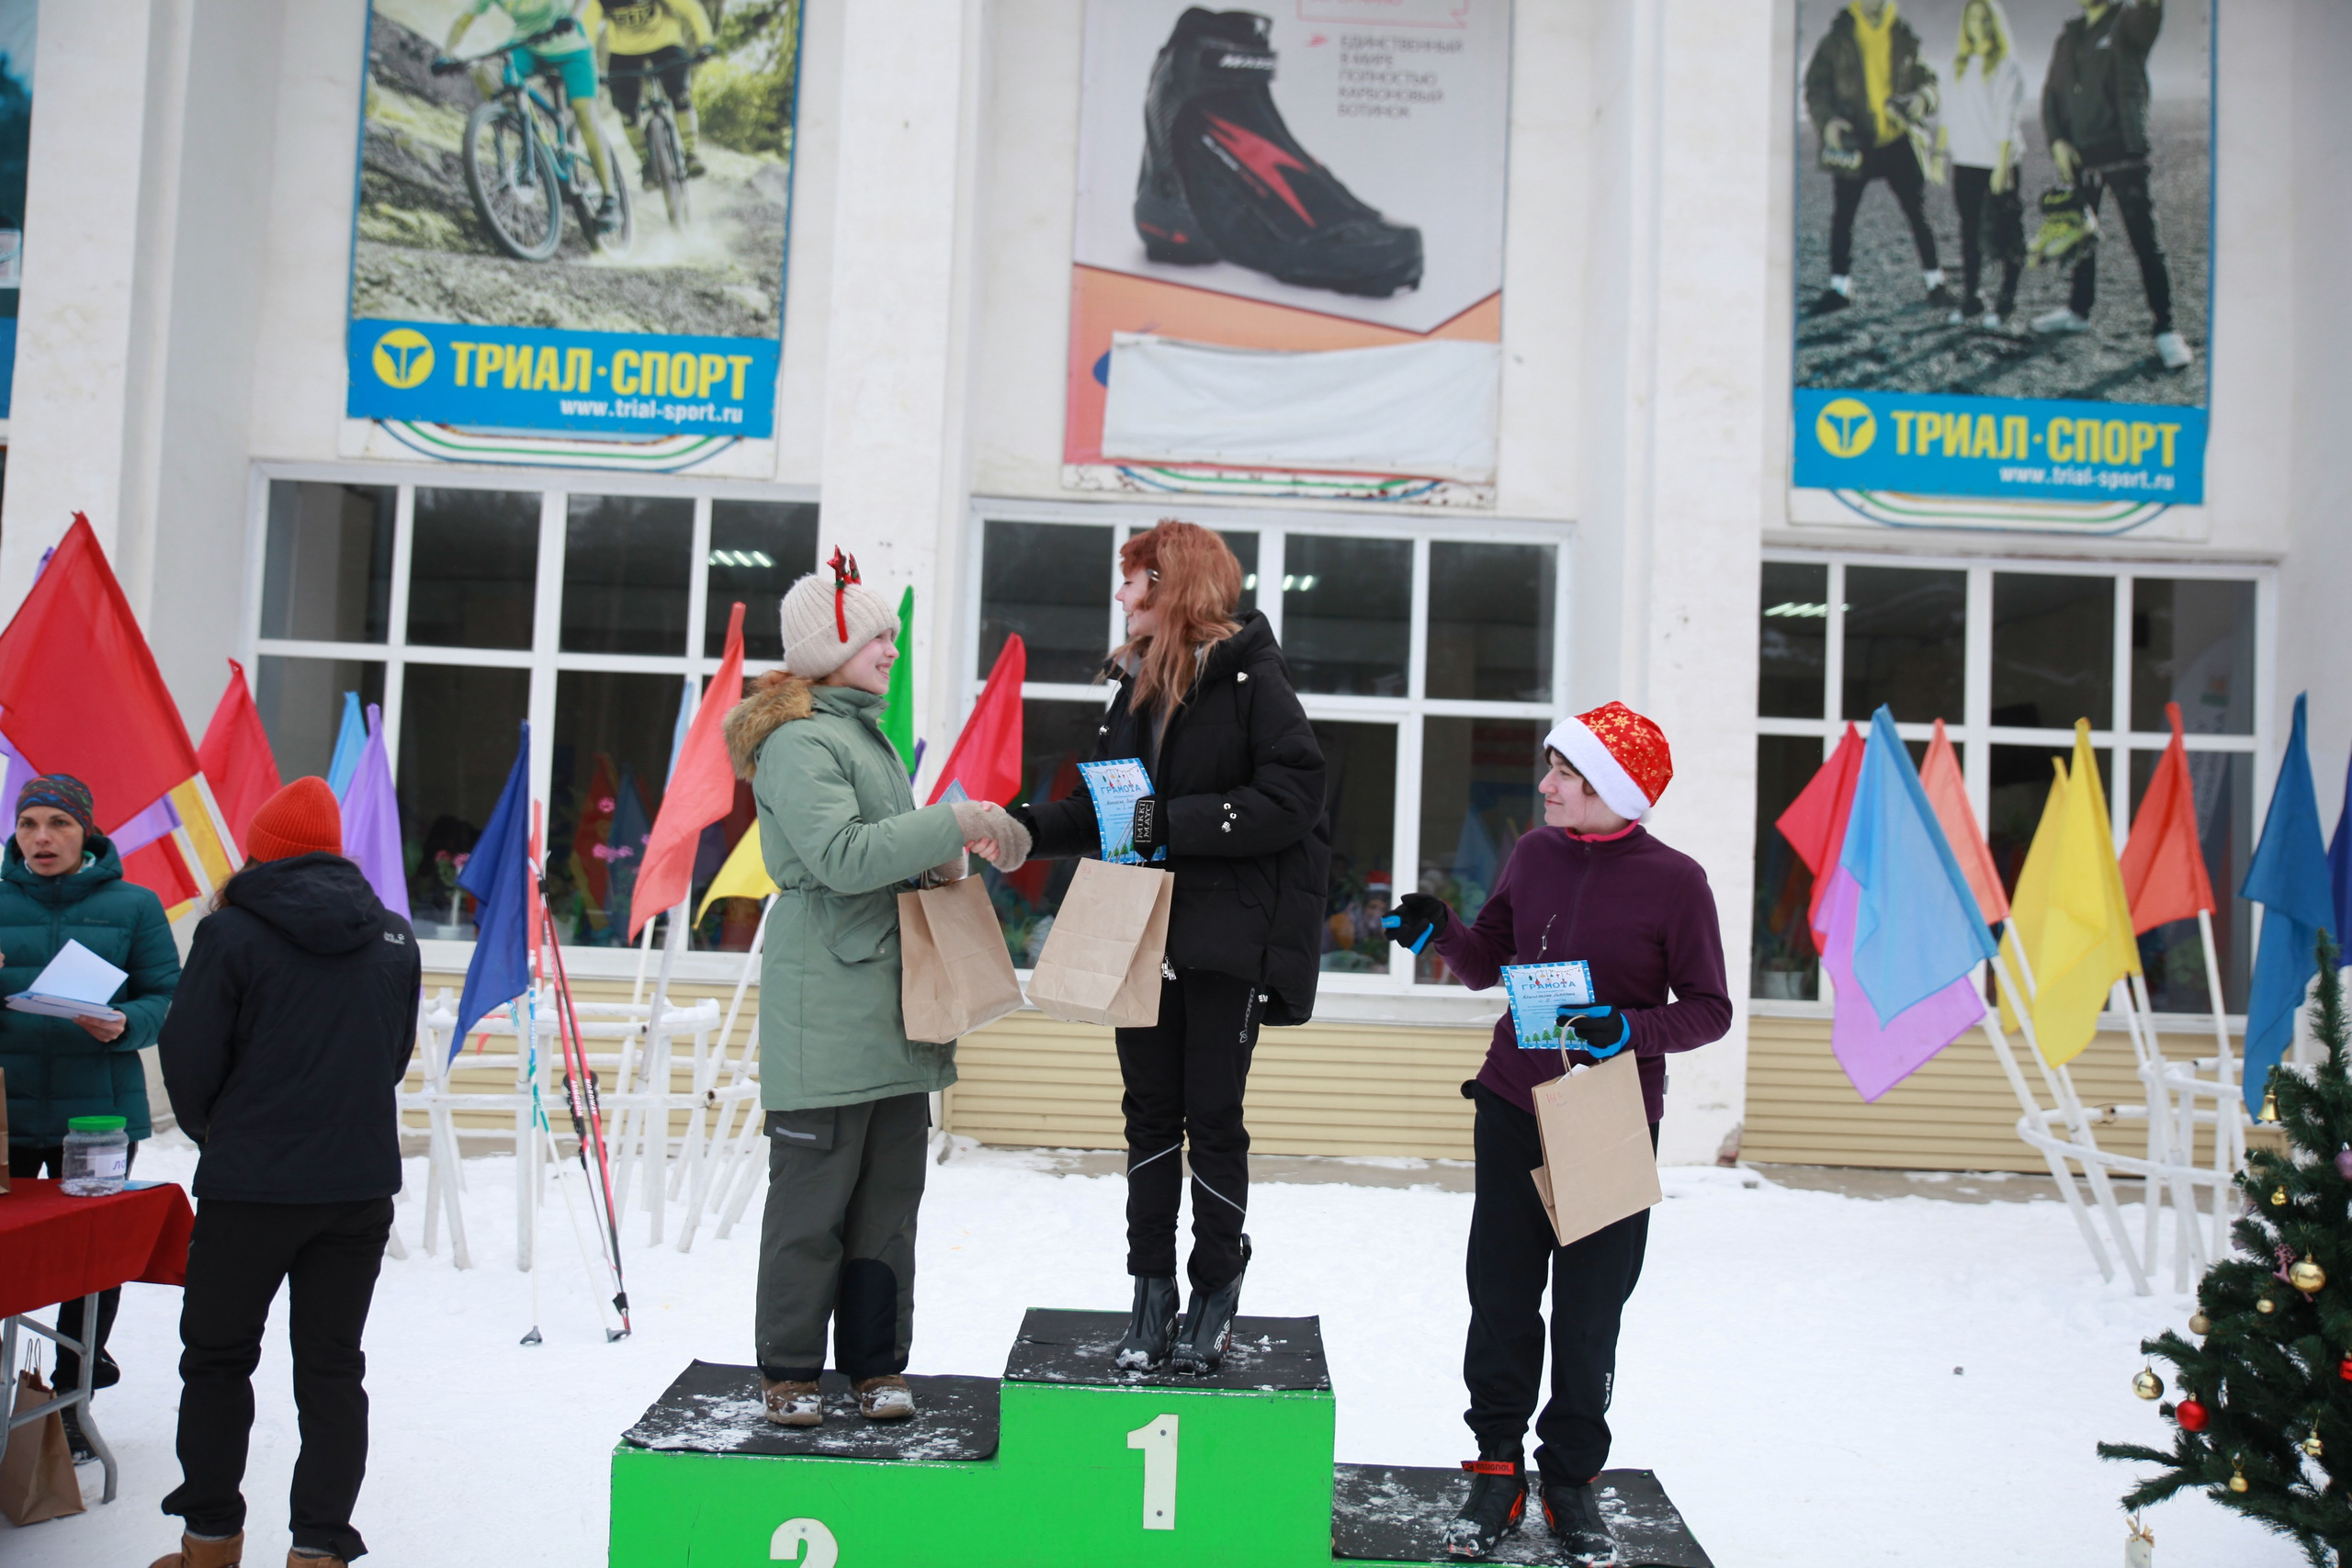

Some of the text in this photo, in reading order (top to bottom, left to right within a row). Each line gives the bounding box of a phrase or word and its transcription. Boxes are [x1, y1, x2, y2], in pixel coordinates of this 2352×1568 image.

[1340, 34, 1464, 52] ЕДИНСТВЕННЫЙ
[1339, 71, 1438, 87] ПОЛНОСТЬЮ
[1339, 87, 1444, 104] КАРБОНОВЫЙ
[1338, 104, 1412, 118] БОТИНОК
[560, 399, 743, 423] www.trial-sport.ru
[1999, 466, 2175, 491] www.trial-sport.ru
[1100, 784, 1142, 795] ГРАМОТА
[1521, 981, 1577, 990] ГРАМОТА
[571, 1079, 583, 1117] NORDWAY
[584, 1078, 598, 1115] NORDWAY
[1214, 1319, 1231, 1352] SPINE
[1126, 1414, 1180, 1530] 1
